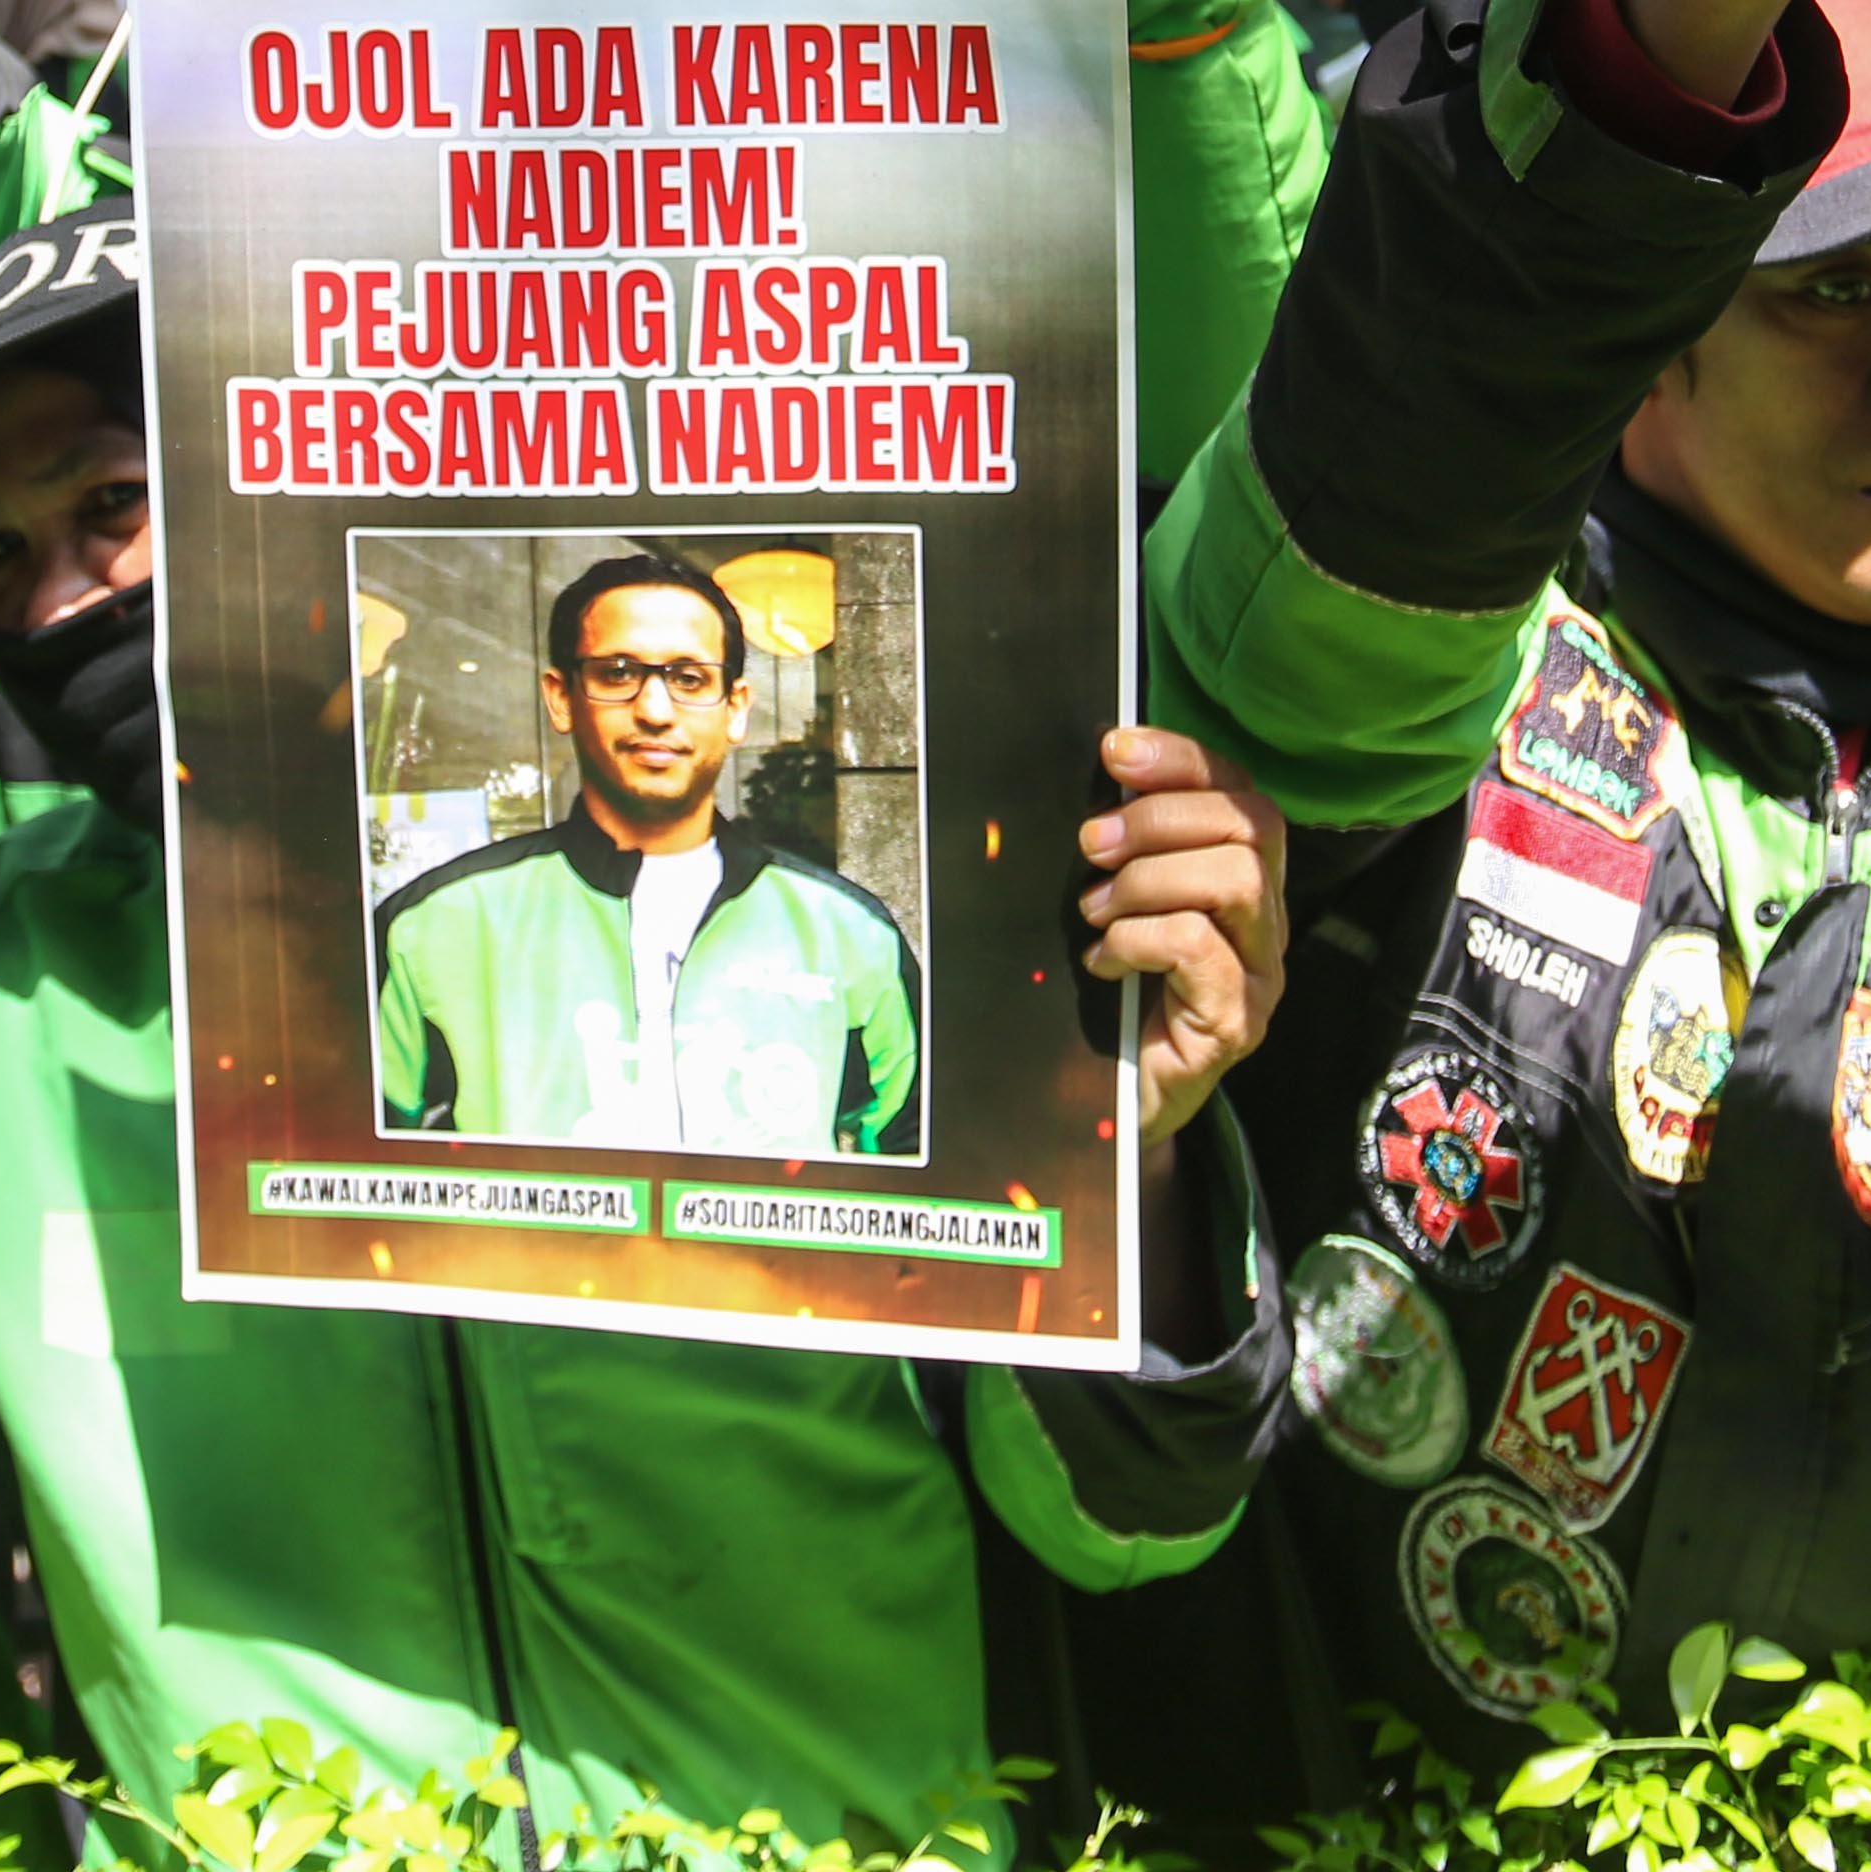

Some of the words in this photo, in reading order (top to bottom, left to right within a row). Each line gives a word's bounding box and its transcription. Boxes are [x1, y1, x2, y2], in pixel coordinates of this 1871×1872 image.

[246, 25, 457, 135] OJOL
[477, 23, 647, 132] ADA
[670, 21, 1003, 132] KARENA
[443, 141, 806, 255] NADIEM!
[296, 261, 673, 377] PEJUANG
[692, 258, 967, 374] ASPAL
[230, 380, 635, 493] BERSAMA
[650, 377, 1014, 493] NADIEM!
[1518, 729, 1642, 819] LOMBOK
[1465, 916, 1588, 1007] SHOLEH
[267, 1176, 631, 1221] #KAWALKAWANPEJUANGASPAL
[681, 1197, 1041, 1250] #SOLIDARITASORANGJALANAN
